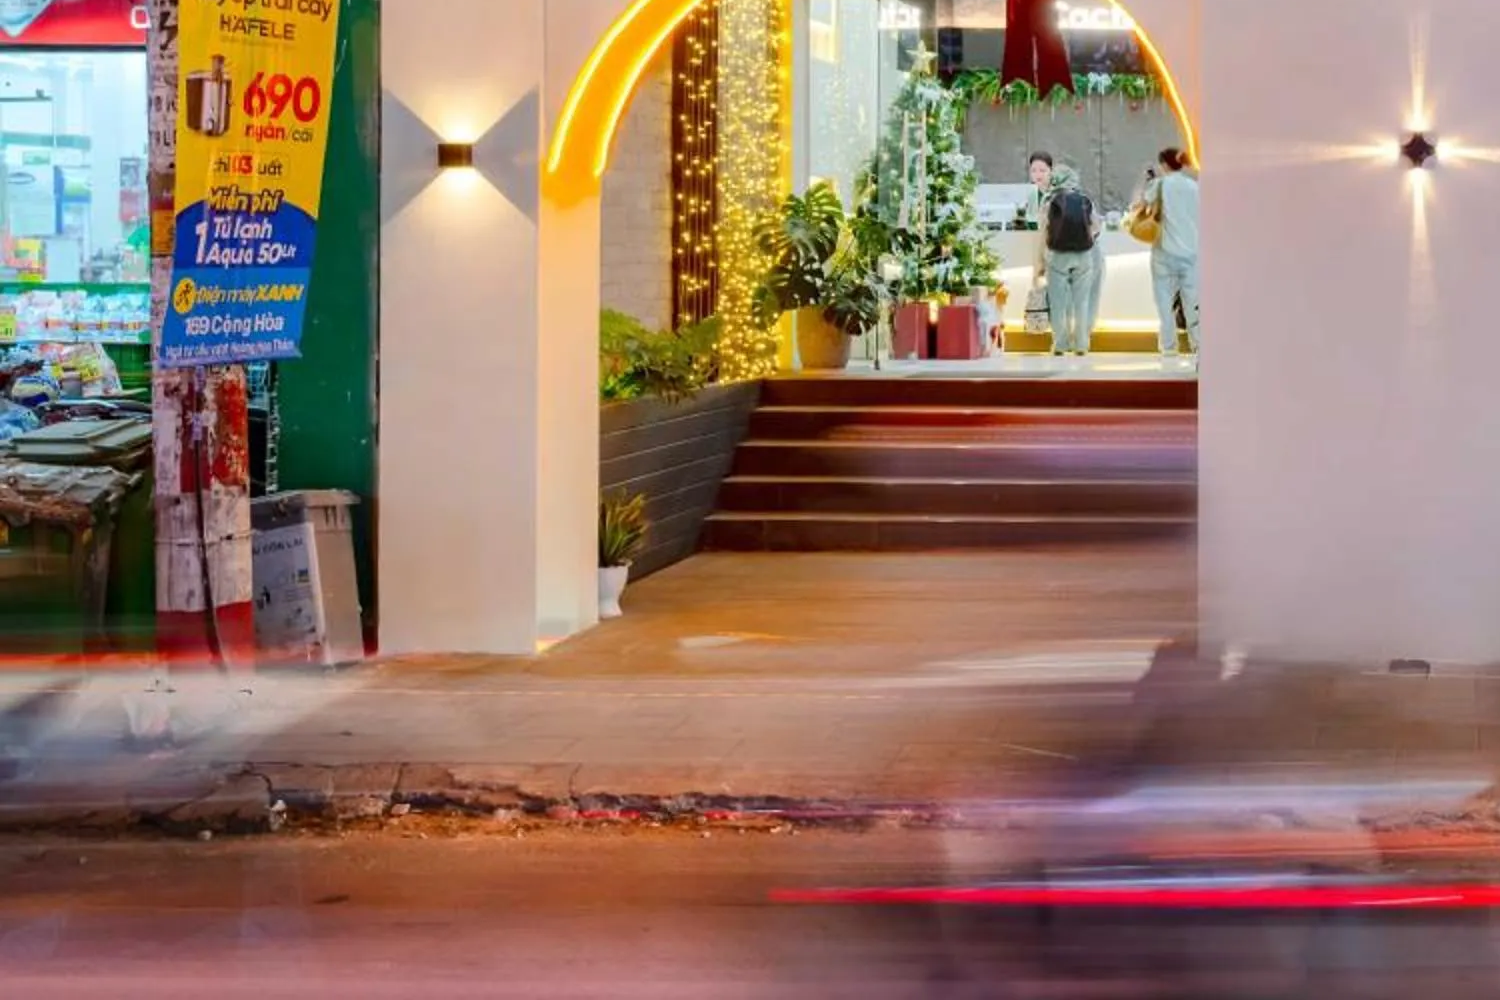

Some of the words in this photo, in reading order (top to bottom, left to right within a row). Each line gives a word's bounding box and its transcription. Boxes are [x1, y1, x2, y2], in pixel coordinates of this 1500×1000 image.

[243, 71, 320, 122] 690
[195, 220, 208, 264] 1
[205, 242, 254, 269] Aqua
